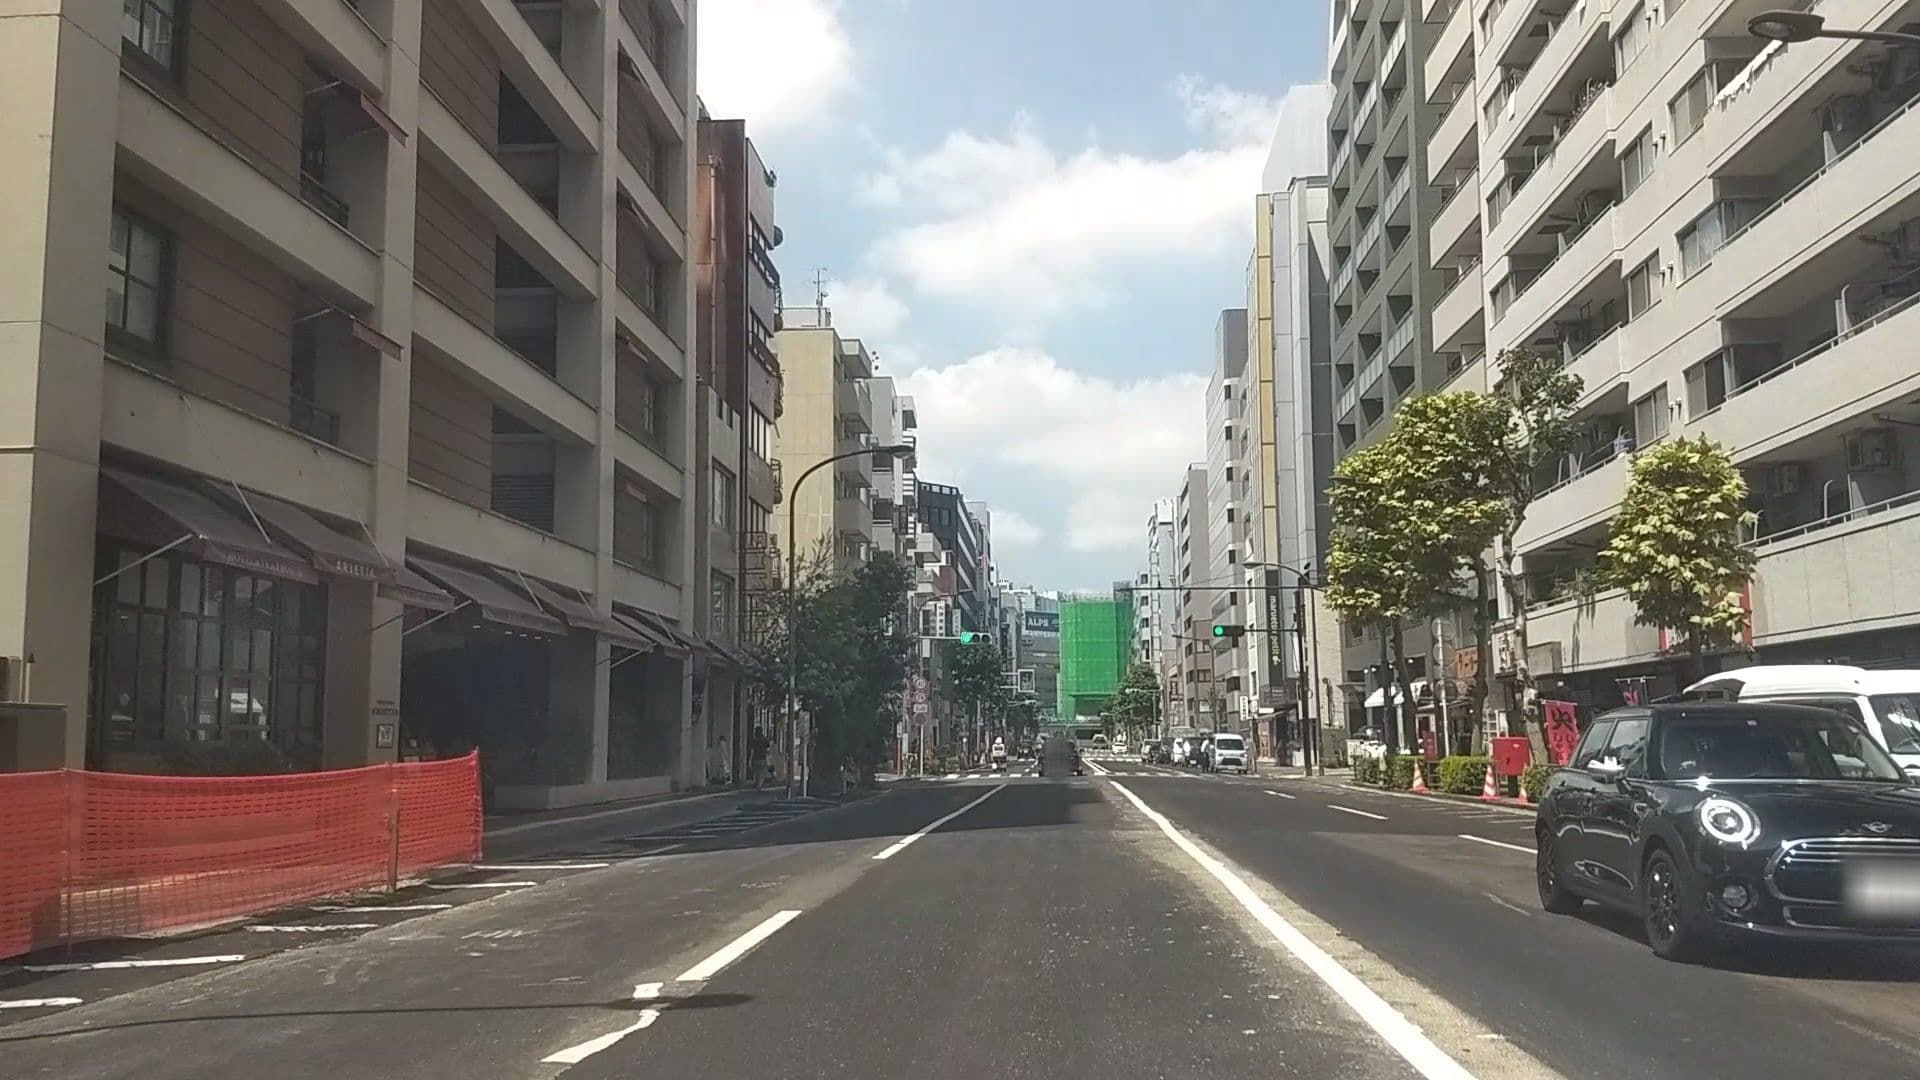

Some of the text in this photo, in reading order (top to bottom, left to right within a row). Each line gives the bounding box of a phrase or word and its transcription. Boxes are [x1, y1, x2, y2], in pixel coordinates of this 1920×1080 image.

[336, 560, 377, 578] ARIETTA
[1028, 618, 1049, 627] ALPS
[1270, 635, 1280, 655] petit
